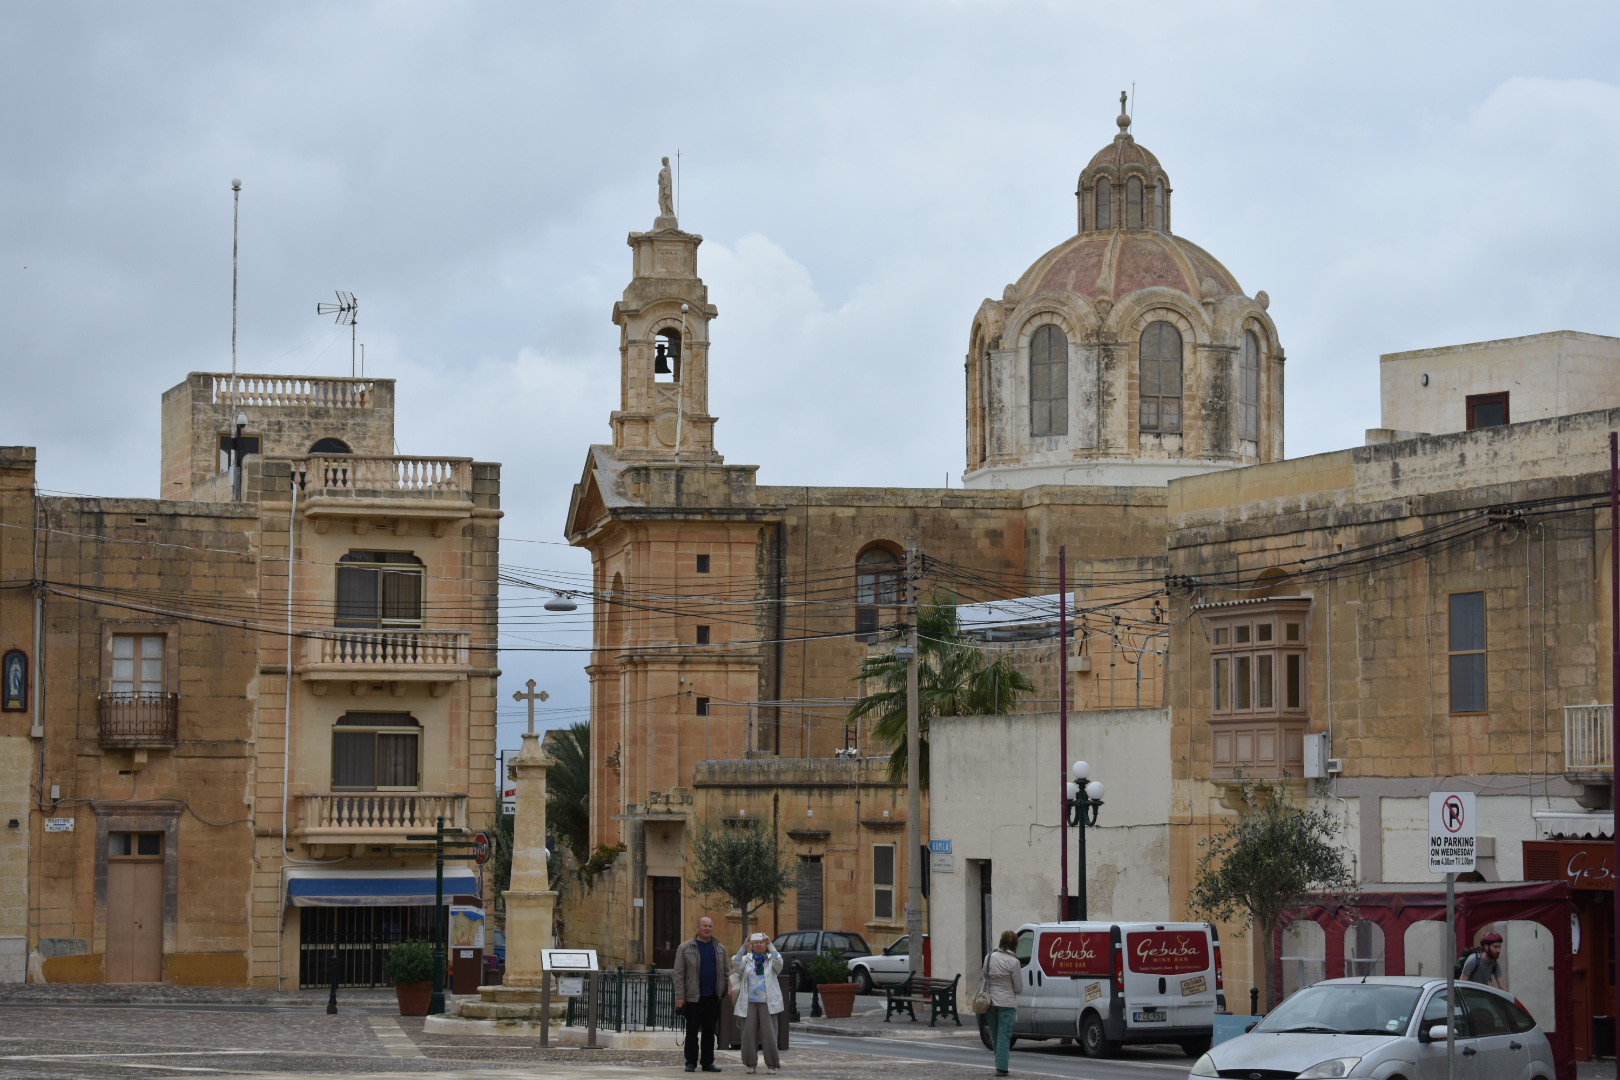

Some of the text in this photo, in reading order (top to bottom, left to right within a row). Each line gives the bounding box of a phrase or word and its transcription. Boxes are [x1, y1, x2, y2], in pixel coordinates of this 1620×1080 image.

[1431, 836, 1474, 847] NO PARKING
[1430, 848, 1474, 857] ON WEDNESDAY
[1430, 858, 1440, 866] From
[1049, 936, 1096, 968] Gebuba
[1136, 937, 1200, 963] Gebuba
